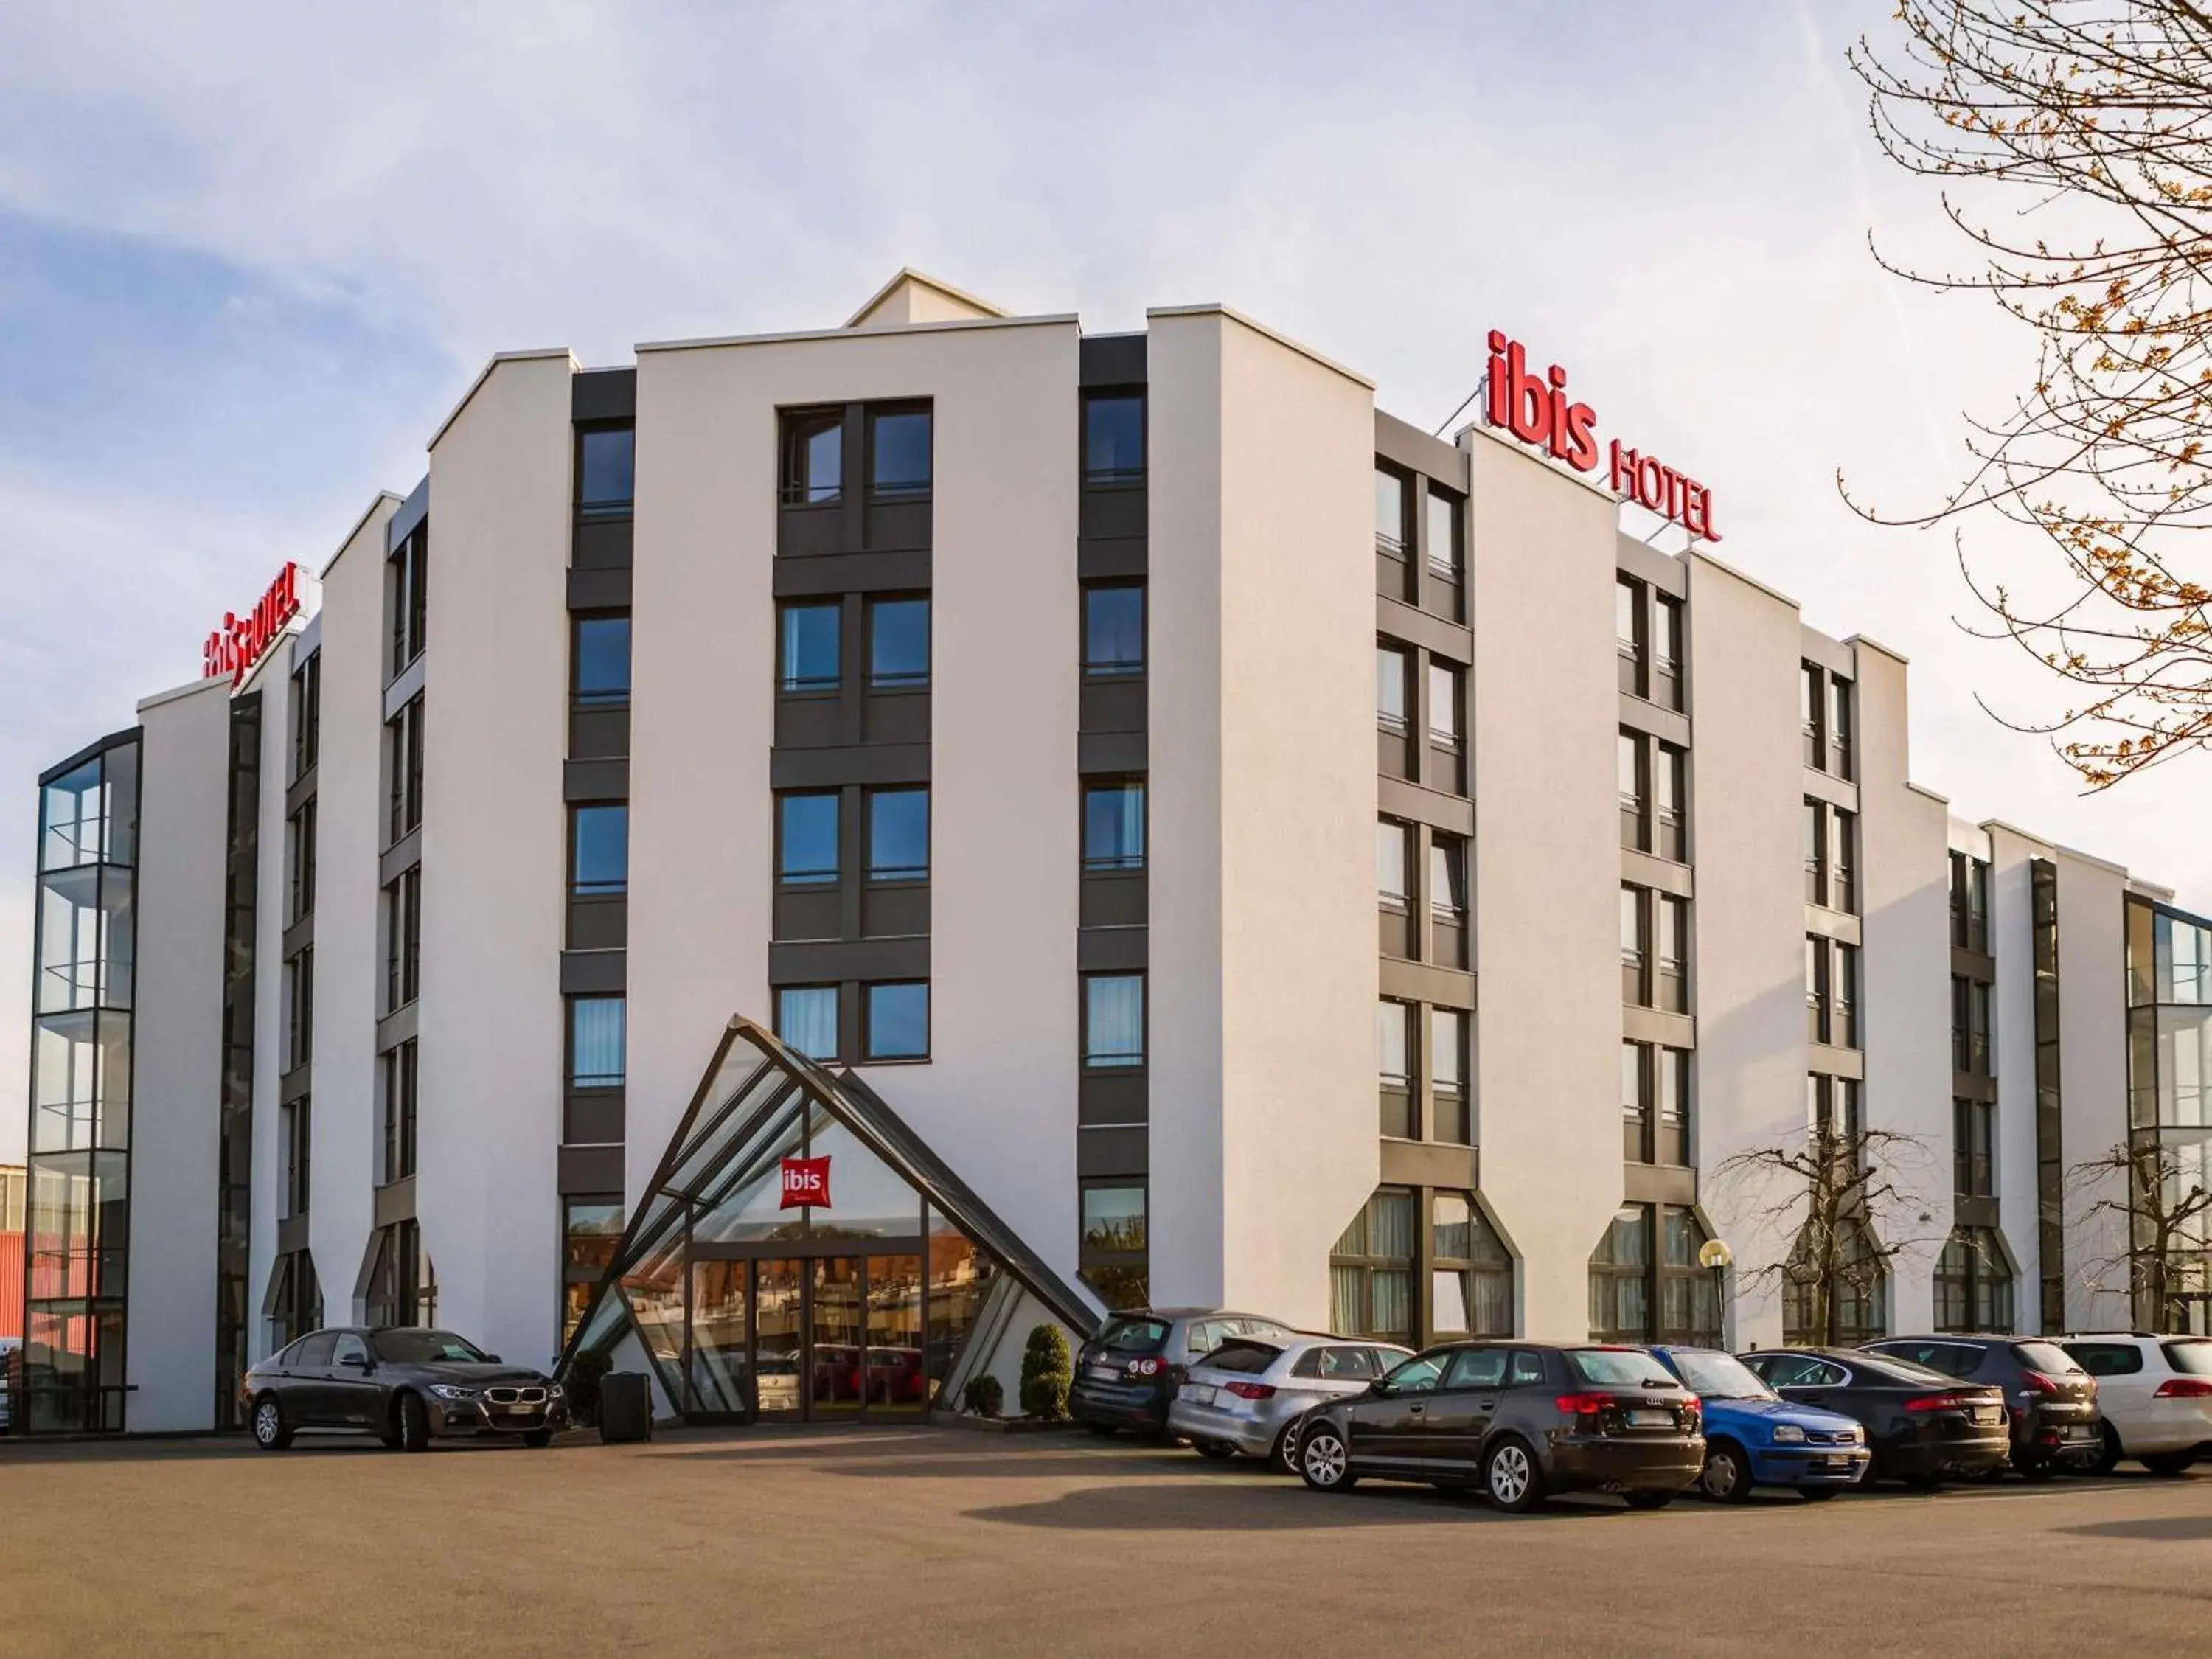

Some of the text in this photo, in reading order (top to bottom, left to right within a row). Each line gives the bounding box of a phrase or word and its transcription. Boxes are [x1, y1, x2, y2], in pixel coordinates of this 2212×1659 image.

[1487, 329, 1722, 543] ibis HOTEL
[784, 1169, 821, 1191] ibis
